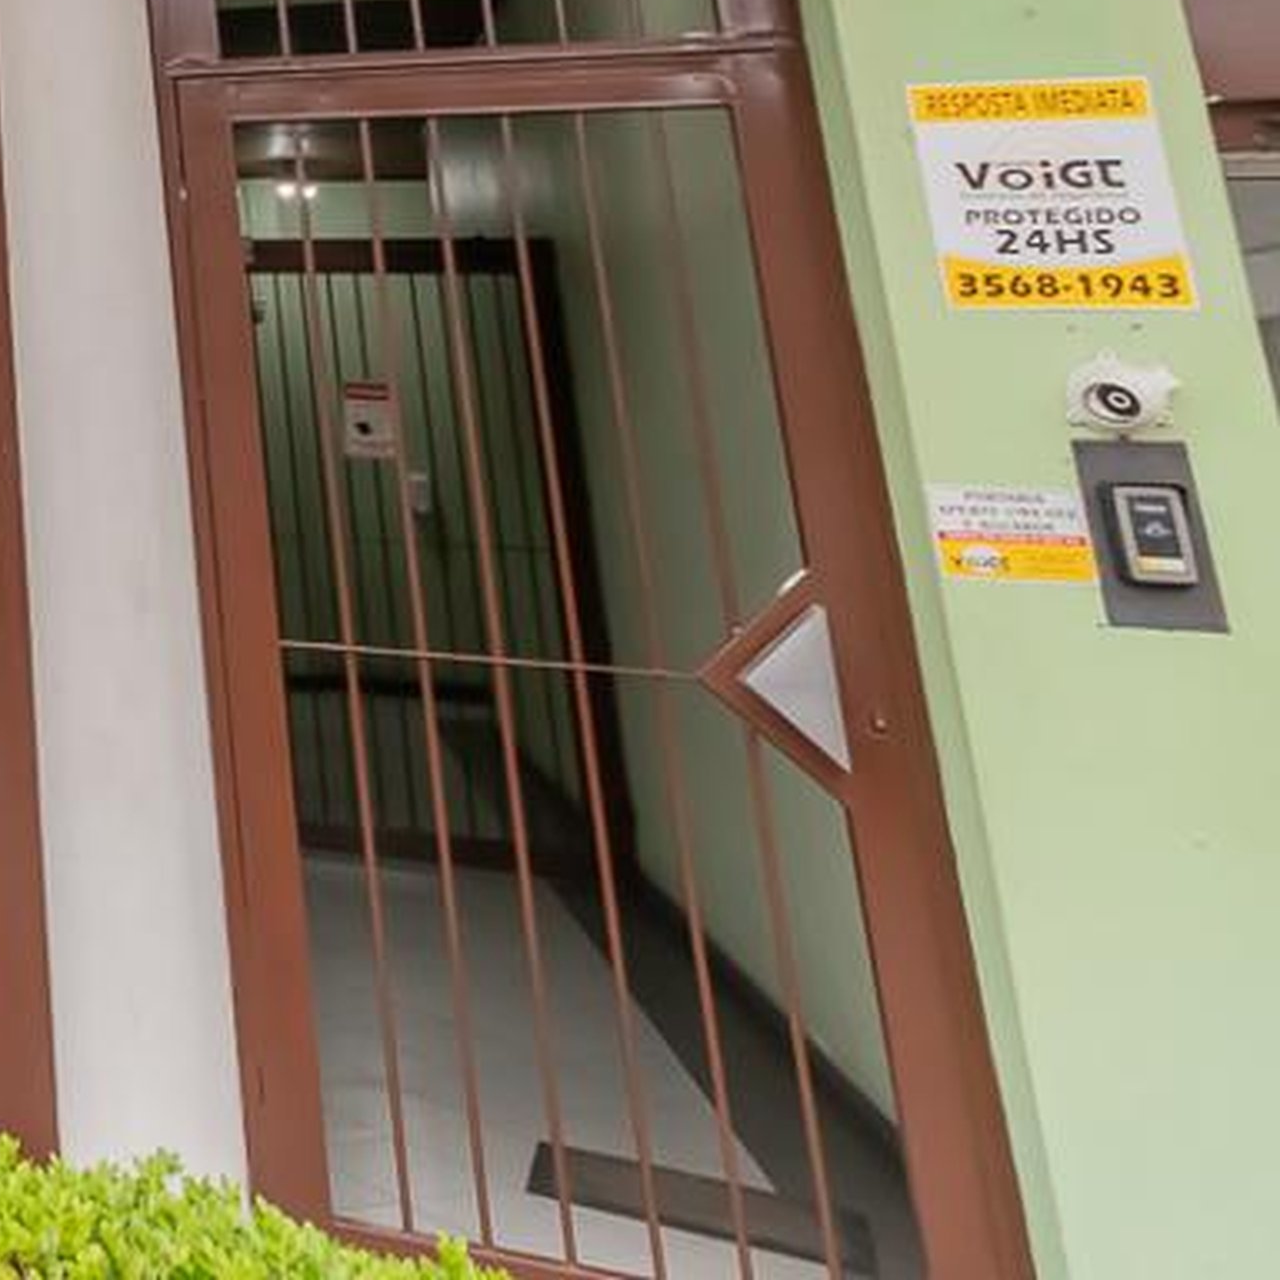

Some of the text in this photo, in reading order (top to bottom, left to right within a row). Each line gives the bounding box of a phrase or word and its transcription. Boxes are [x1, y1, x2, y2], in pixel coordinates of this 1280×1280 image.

[926, 92, 1026, 116] RESPOSTA
[965, 207, 1142, 224] PROTEGIDO
[995, 228, 1115, 255] 24HS
[958, 273, 1181, 298] 3568-1943
